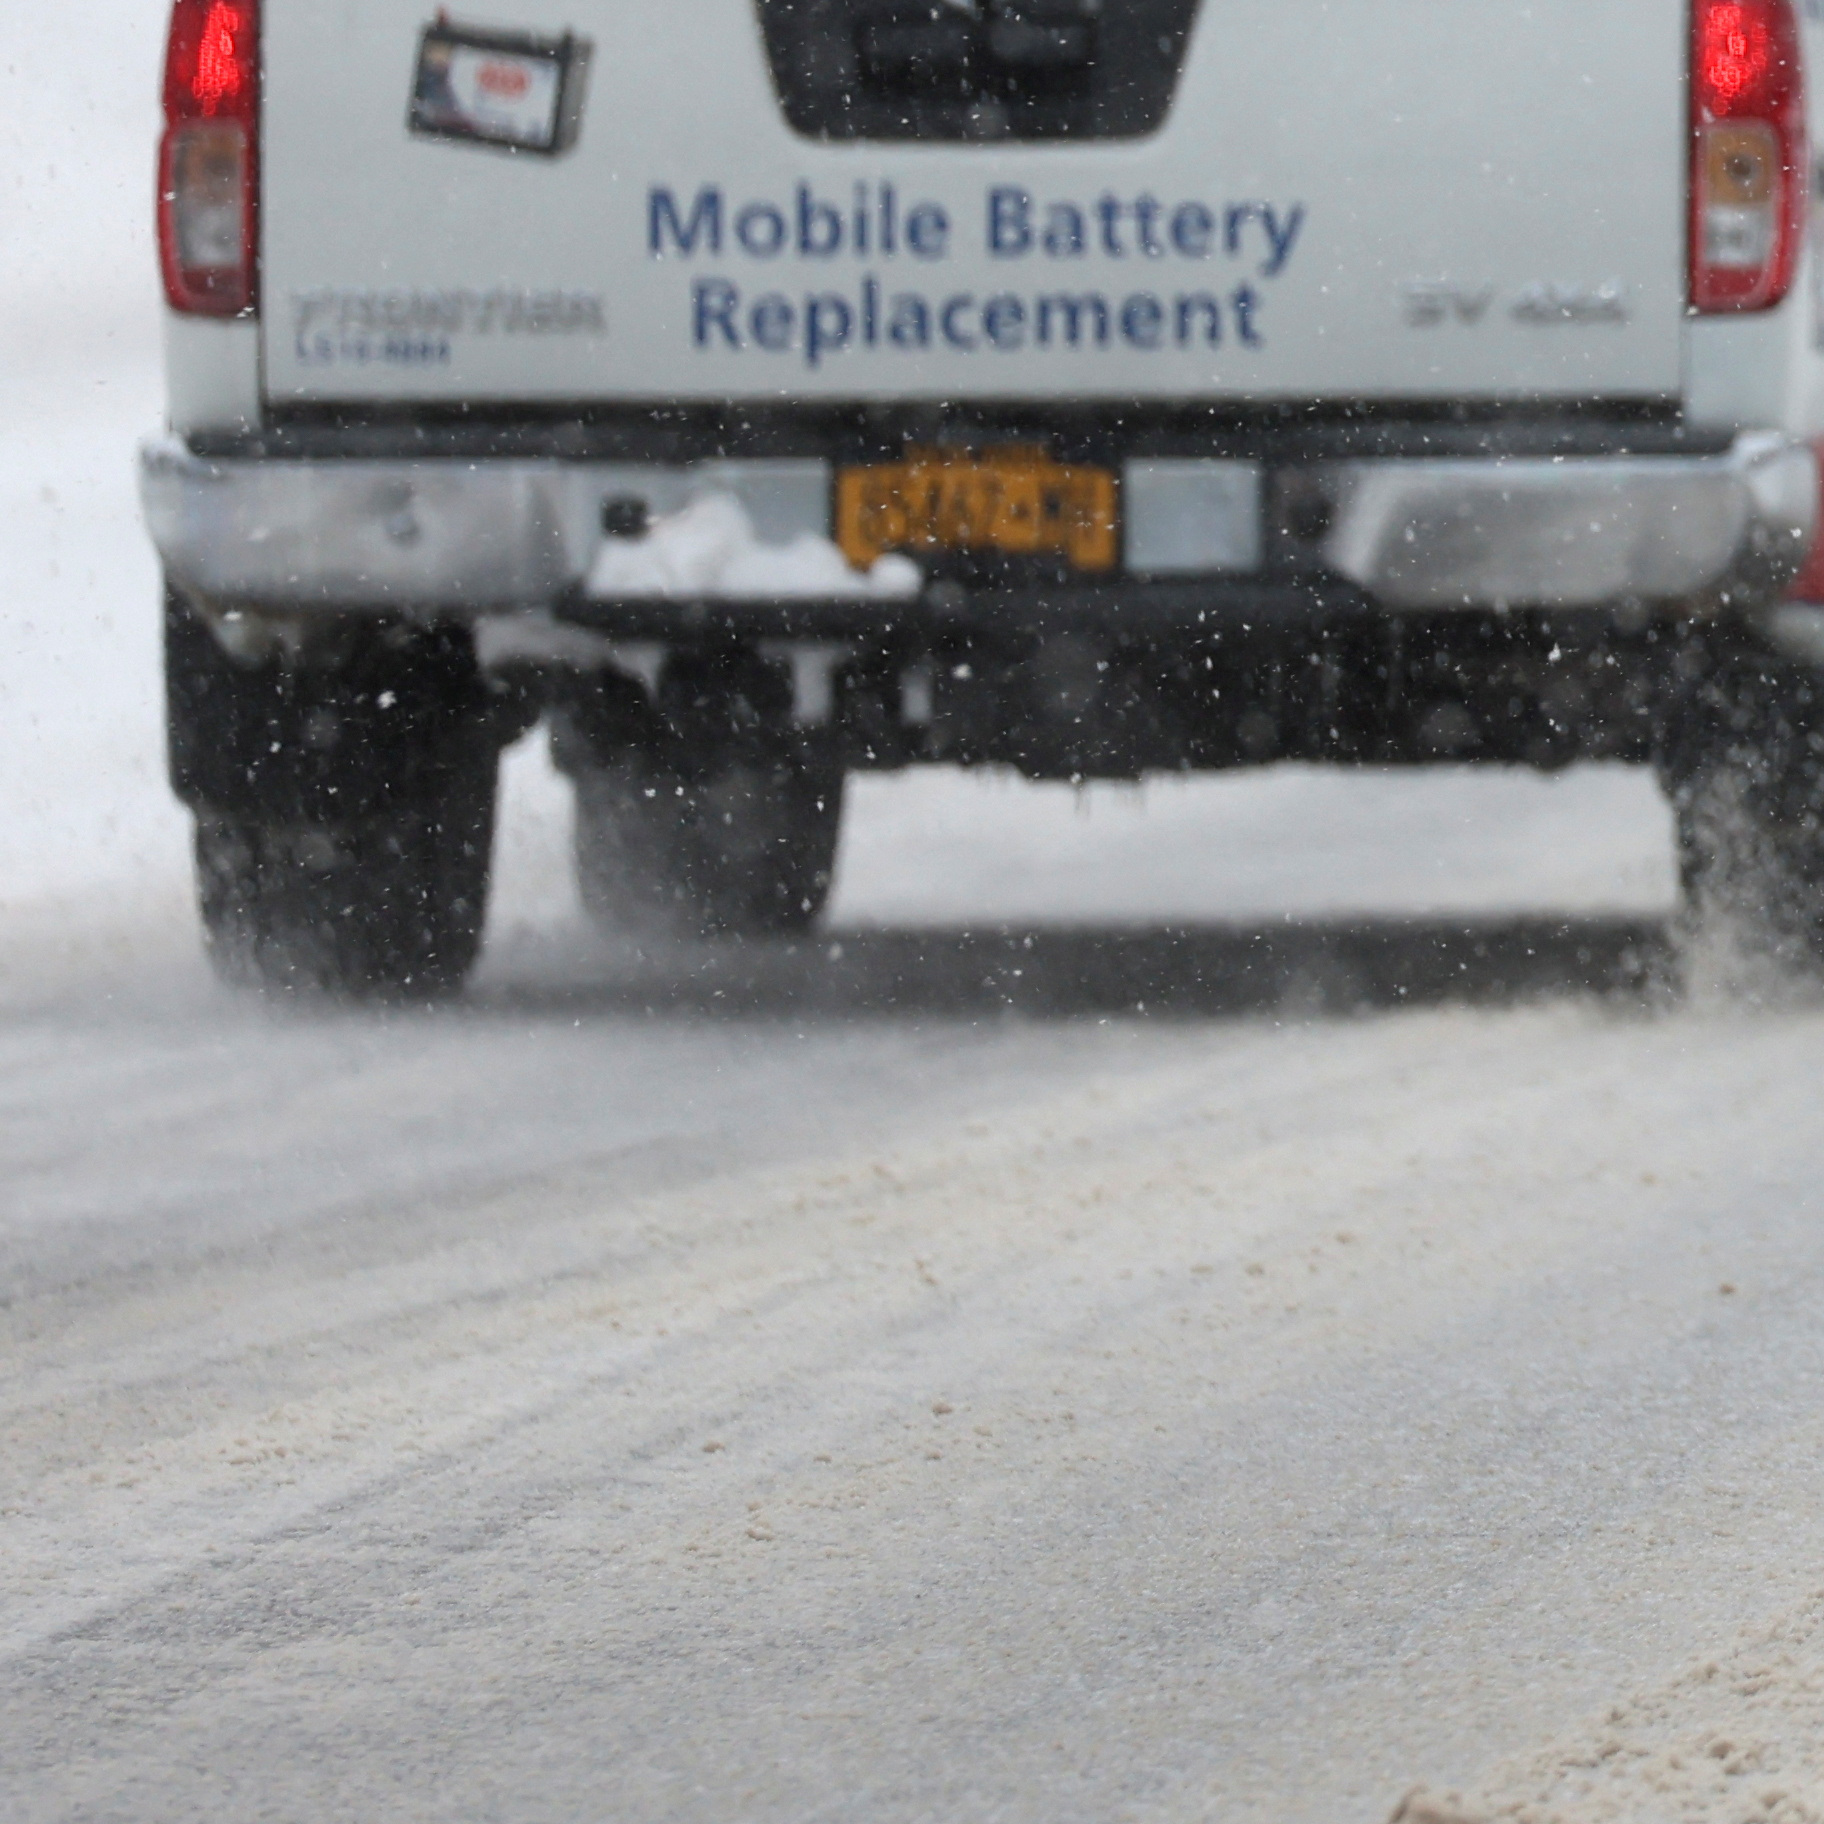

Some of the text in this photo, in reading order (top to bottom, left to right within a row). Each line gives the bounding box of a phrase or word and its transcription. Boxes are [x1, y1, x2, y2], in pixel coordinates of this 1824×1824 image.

[645, 184, 1308, 277] Mobile Battery
[690, 278, 1265, 366] Replacement
